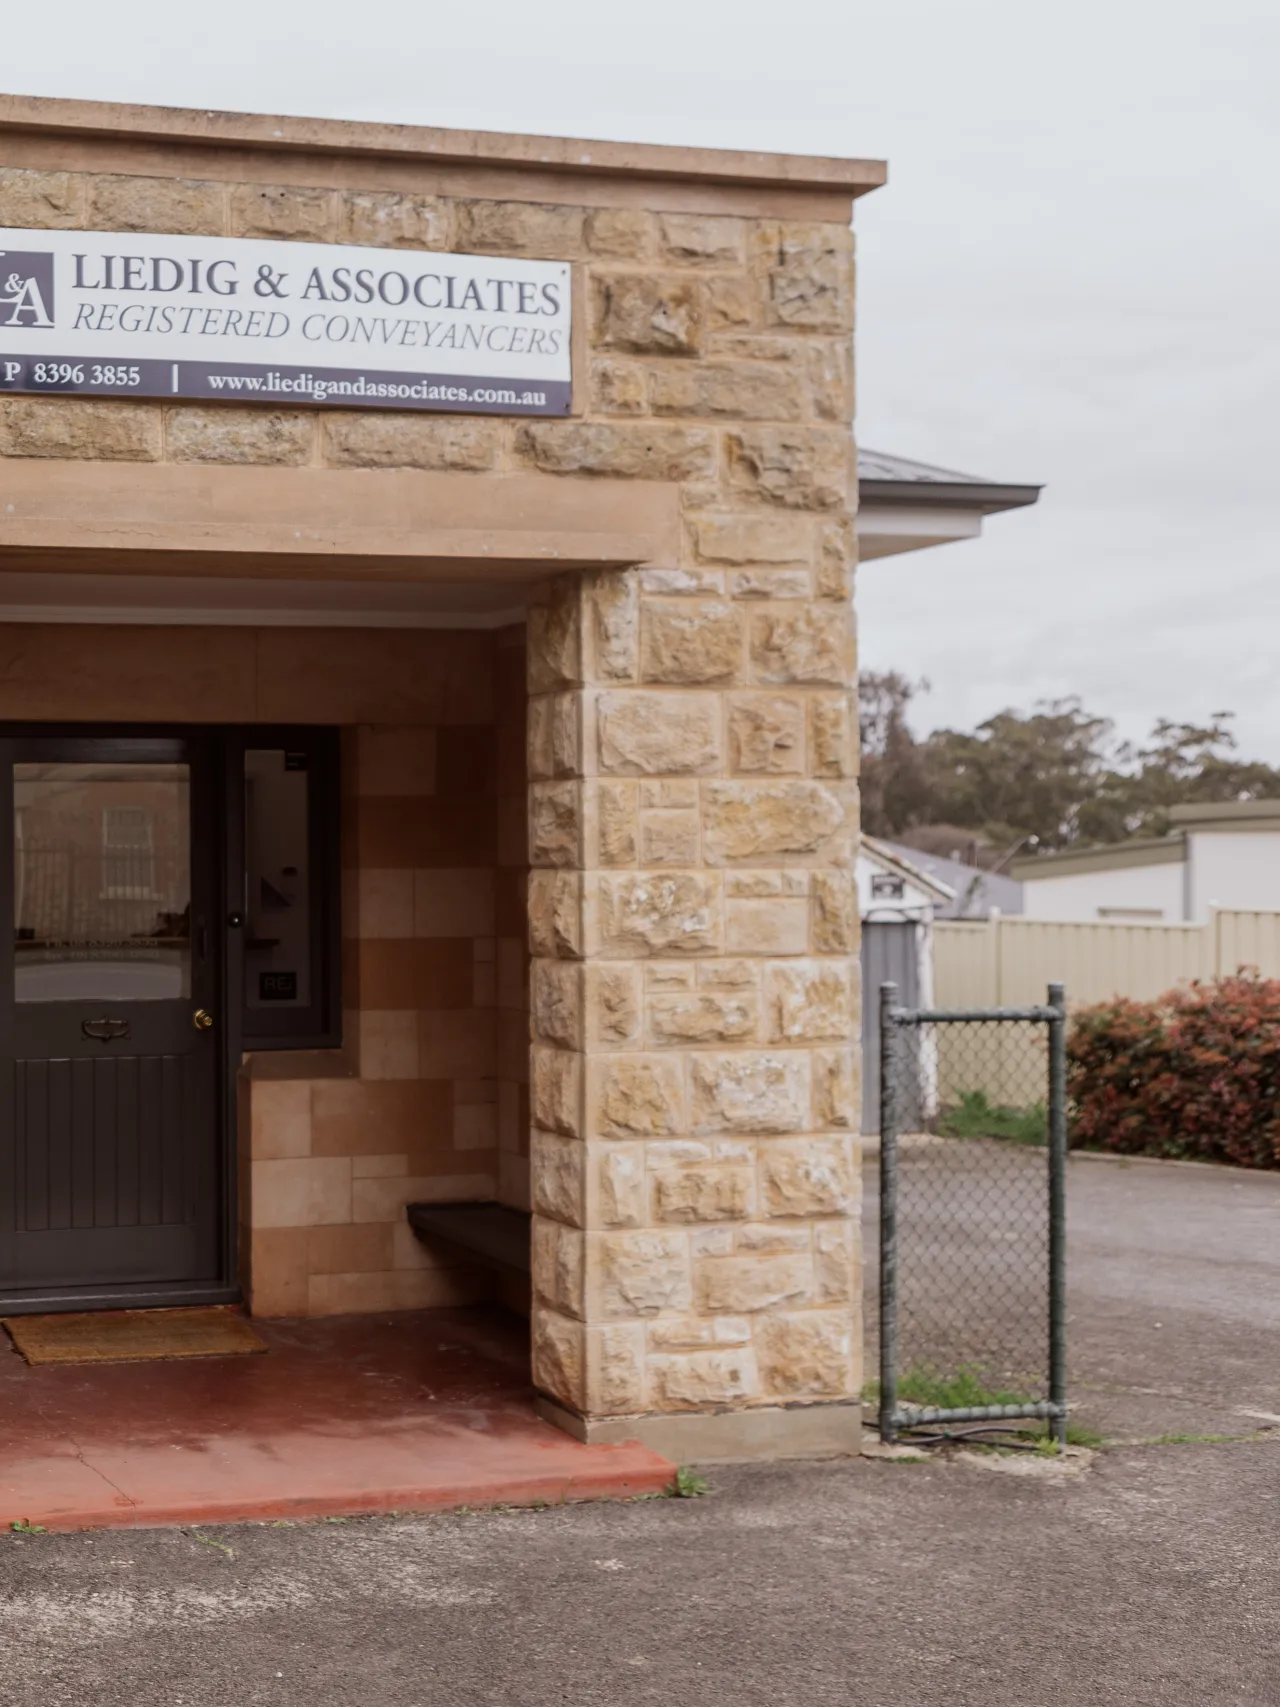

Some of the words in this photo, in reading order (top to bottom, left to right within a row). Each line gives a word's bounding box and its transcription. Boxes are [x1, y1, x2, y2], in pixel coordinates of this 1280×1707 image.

[72, 253, 239, 296] LIEDIG
[253, 263, 289, 299] &
[300, 266, 561, 317] ASSOCIATES
[72, 302, 290, 338] REGISTERED
[302, 313, 562, 355] CONVEYANCERS
[4, 361, 21, 382] P
[33, 362, 85, 385] 8396
[89, 364, 141, 386] 3855
[208, 372, 547, 406] www.liedigandassociates.com.au
